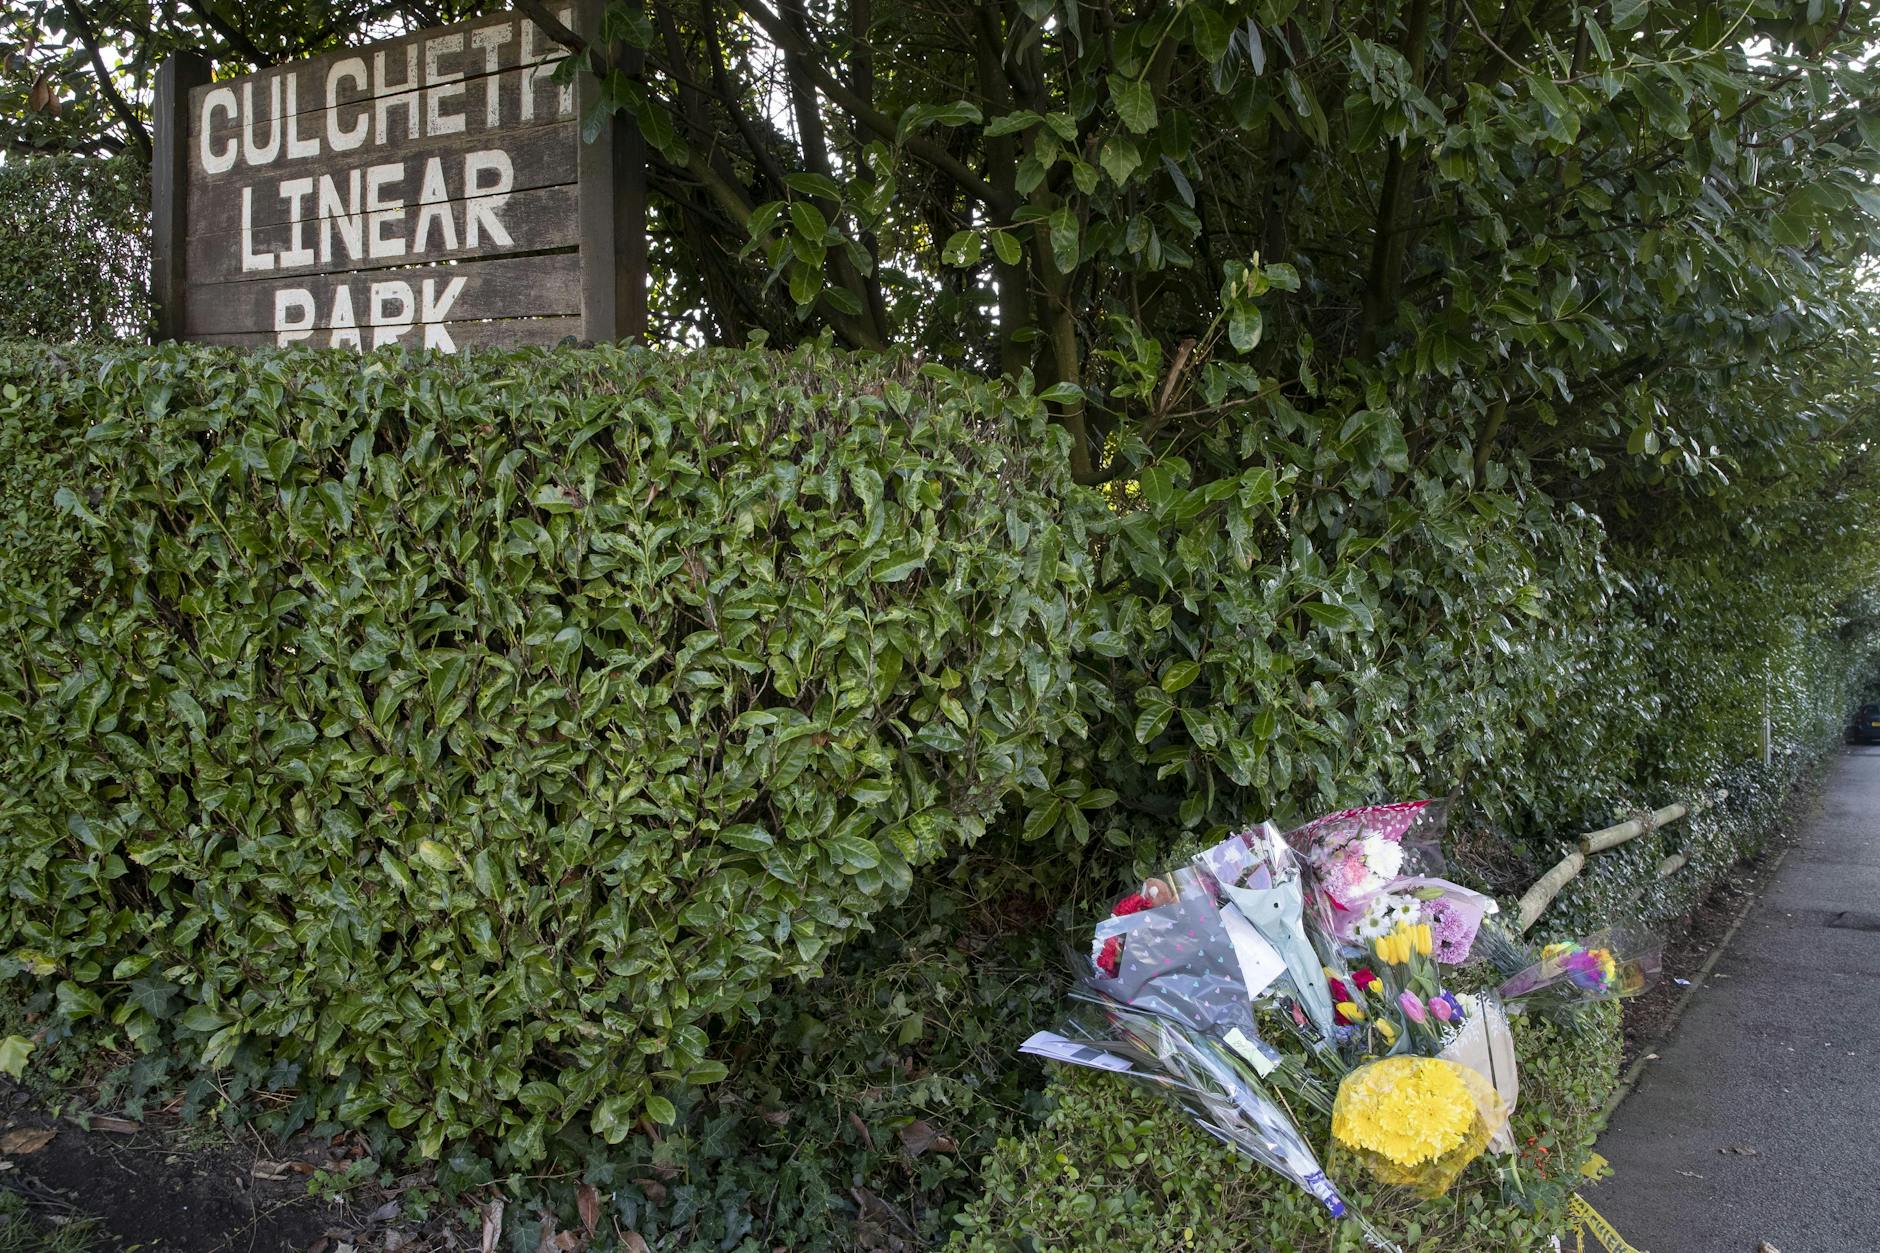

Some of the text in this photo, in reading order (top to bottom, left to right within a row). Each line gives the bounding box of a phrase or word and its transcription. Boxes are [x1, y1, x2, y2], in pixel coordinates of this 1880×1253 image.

[201, 8, 572, 174] CULCHETH
[242, 149, 514, 273] LINEAR
[274, 276, 468, 355] PARK
